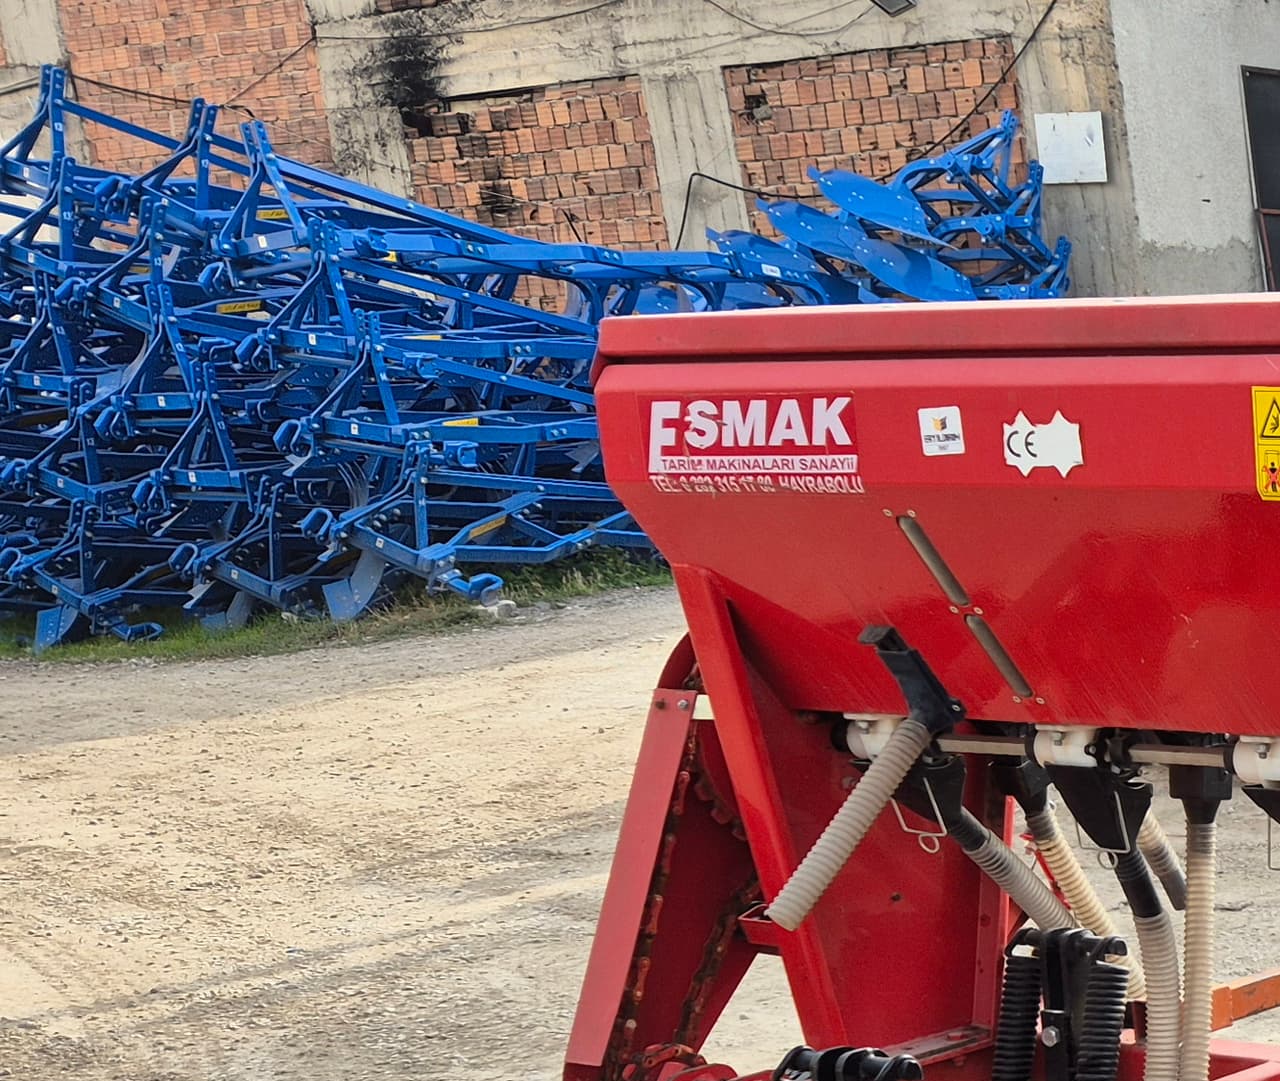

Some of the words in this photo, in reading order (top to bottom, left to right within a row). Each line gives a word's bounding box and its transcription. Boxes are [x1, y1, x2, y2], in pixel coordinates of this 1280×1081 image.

[649, 397, 852, 473] ESMAK
[1007, 430, 1037, 457] CE
[714, 475, 741, 492] 315
[778, 475, 865, 493] HAYRABOLU
